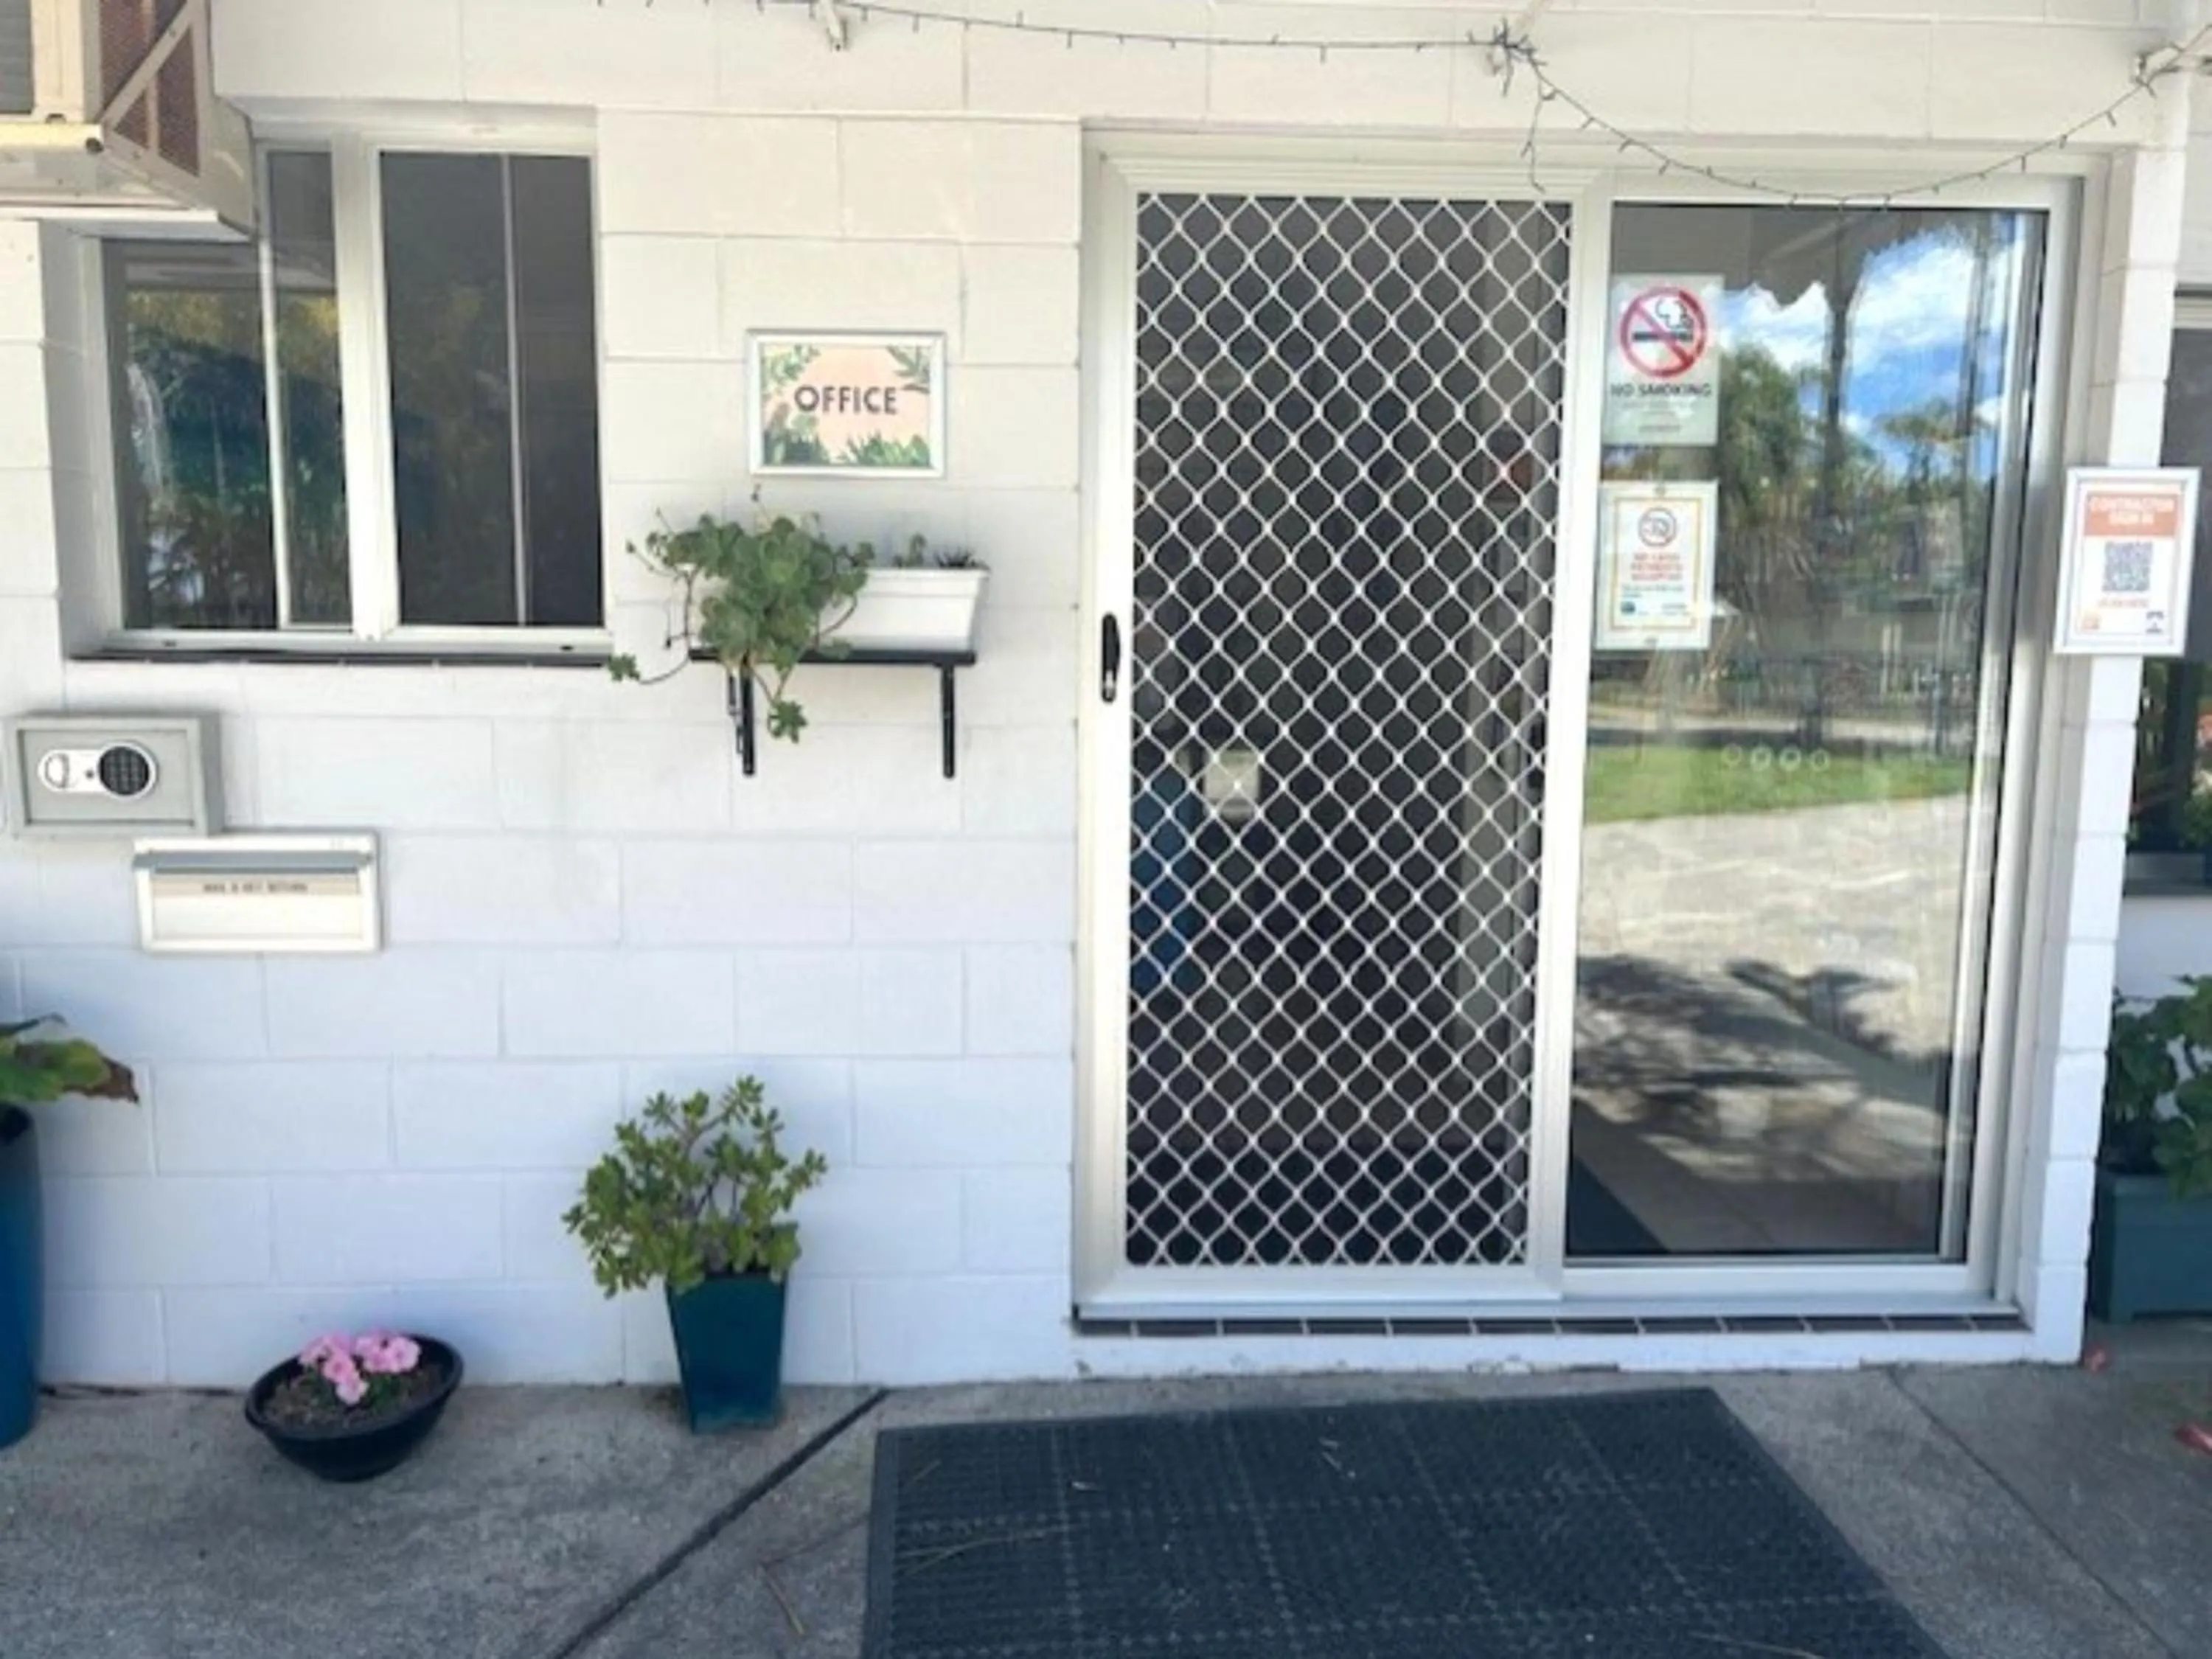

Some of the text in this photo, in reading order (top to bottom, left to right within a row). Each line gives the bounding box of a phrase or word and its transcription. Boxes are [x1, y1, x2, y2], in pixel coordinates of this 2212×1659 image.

[793, 384, 897, 414] OFFICE
[1610, 383, 1712, 397] NO SMOKING
